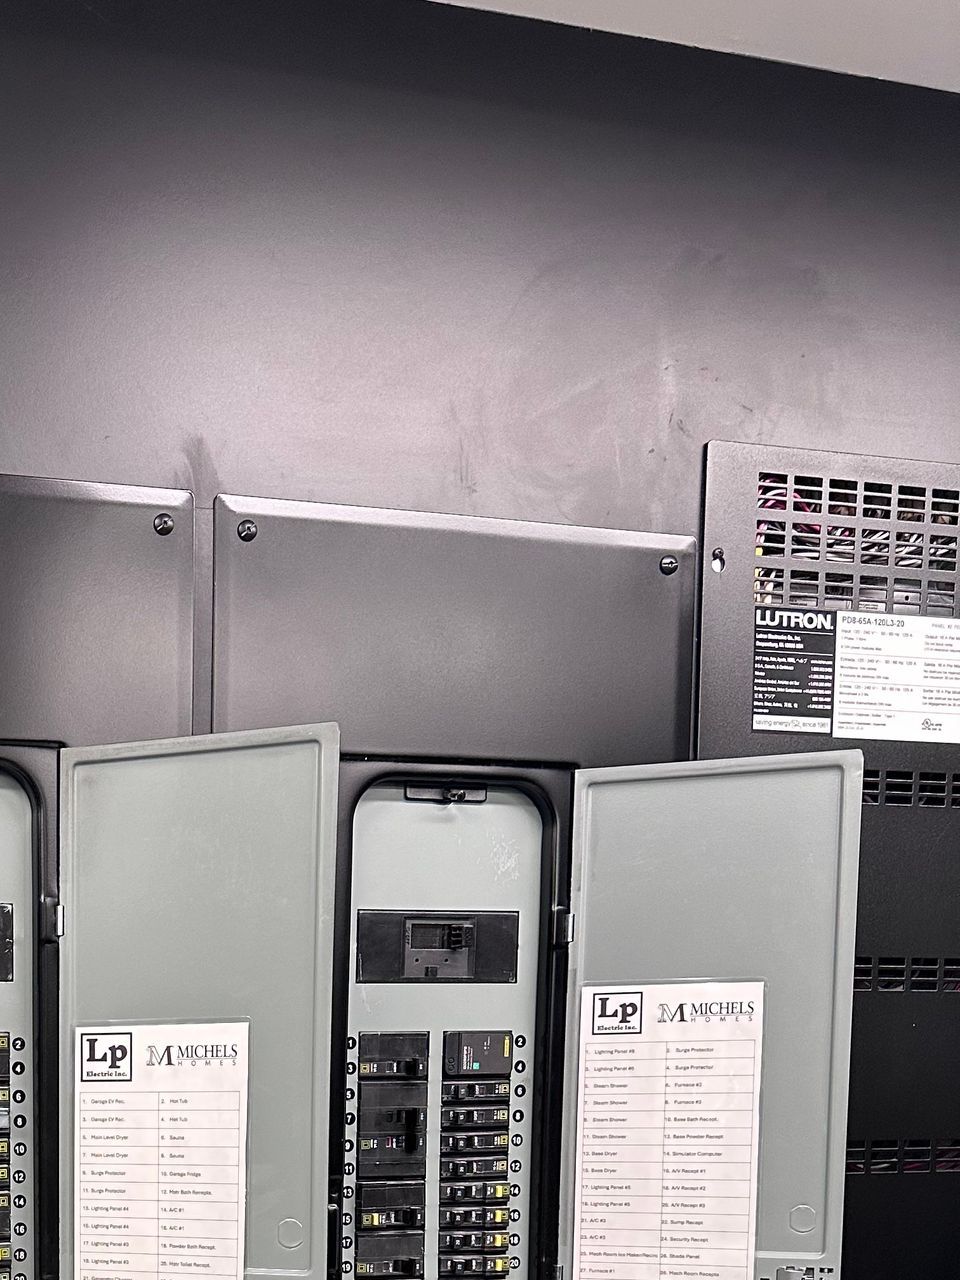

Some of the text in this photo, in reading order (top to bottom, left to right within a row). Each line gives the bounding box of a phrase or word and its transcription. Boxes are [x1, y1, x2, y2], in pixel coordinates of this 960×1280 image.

[690, 1001, 754, 1015] MICHELS
[15, 1040, 21, 1049] 2
[517, 1037, 523, 1046] 2
[177, 1044, 238, 1058] MICHELS
[15, 1064, 21, 1073] 4
[515, 1112, 521, 1120] 8
[17, 1117, 23, 1126] 8
[15, 1145, 25, 1154] 10
[14, 1197, 24, 1206] 14
[510, 1211, 519, 1220] 16
[15, 1225, 25, 1234] 16
[509, 1259, 519, 1267] 20
